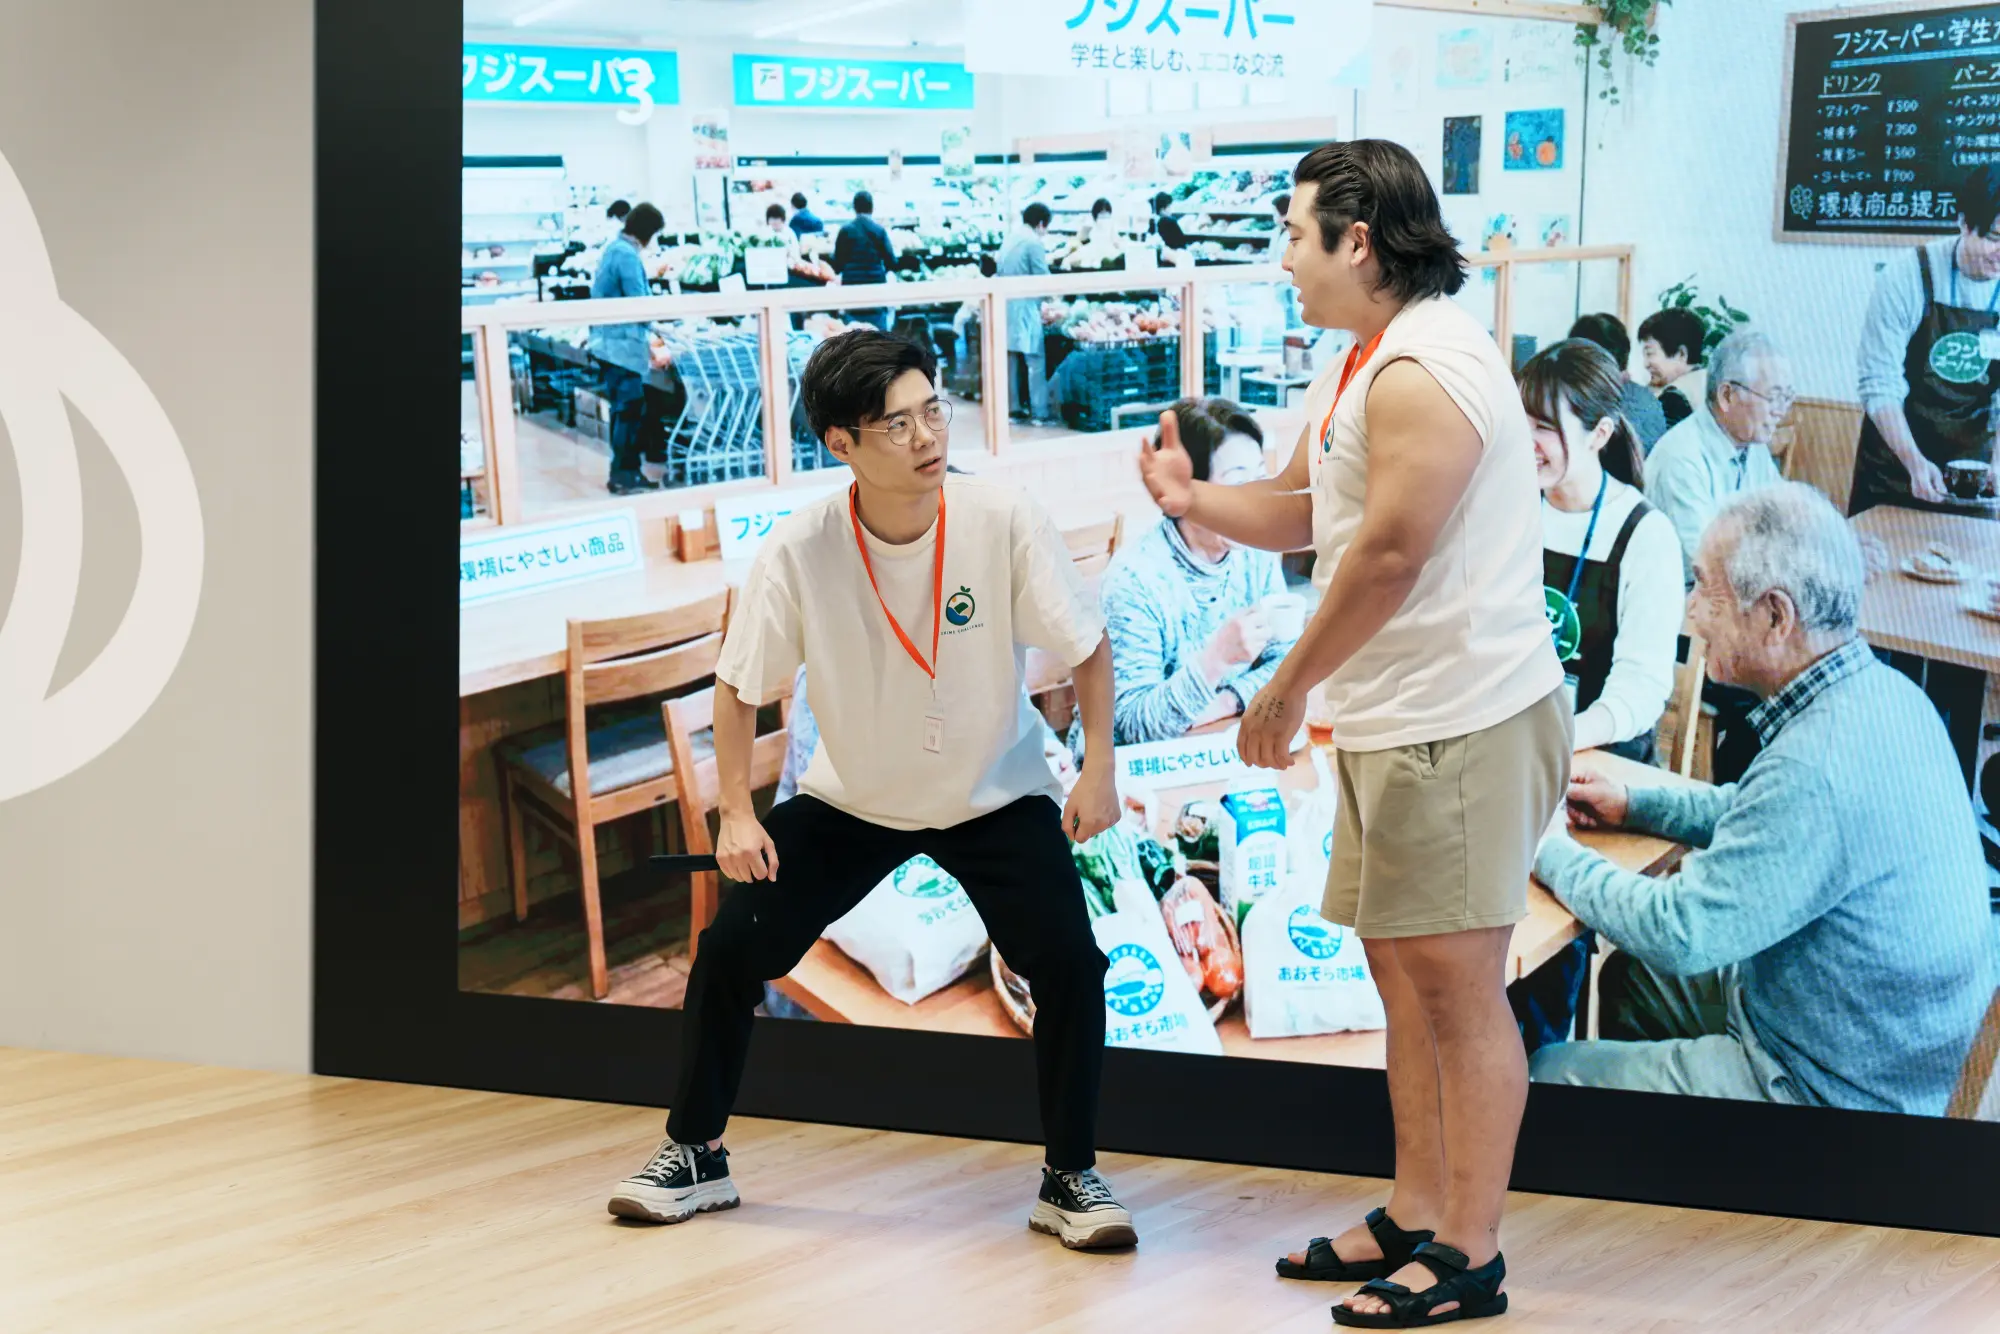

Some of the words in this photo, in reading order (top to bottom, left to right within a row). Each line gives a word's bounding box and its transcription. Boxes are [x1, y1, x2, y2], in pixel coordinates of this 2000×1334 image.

[1071, 42, 1285, 78] 学生と楽しむ、エコな交流
[790, 65, 950, 101] フジスーパー
[731, 509, 792, 541] フジ
[1128, 750, 1241, 776] 環境にやさしい
